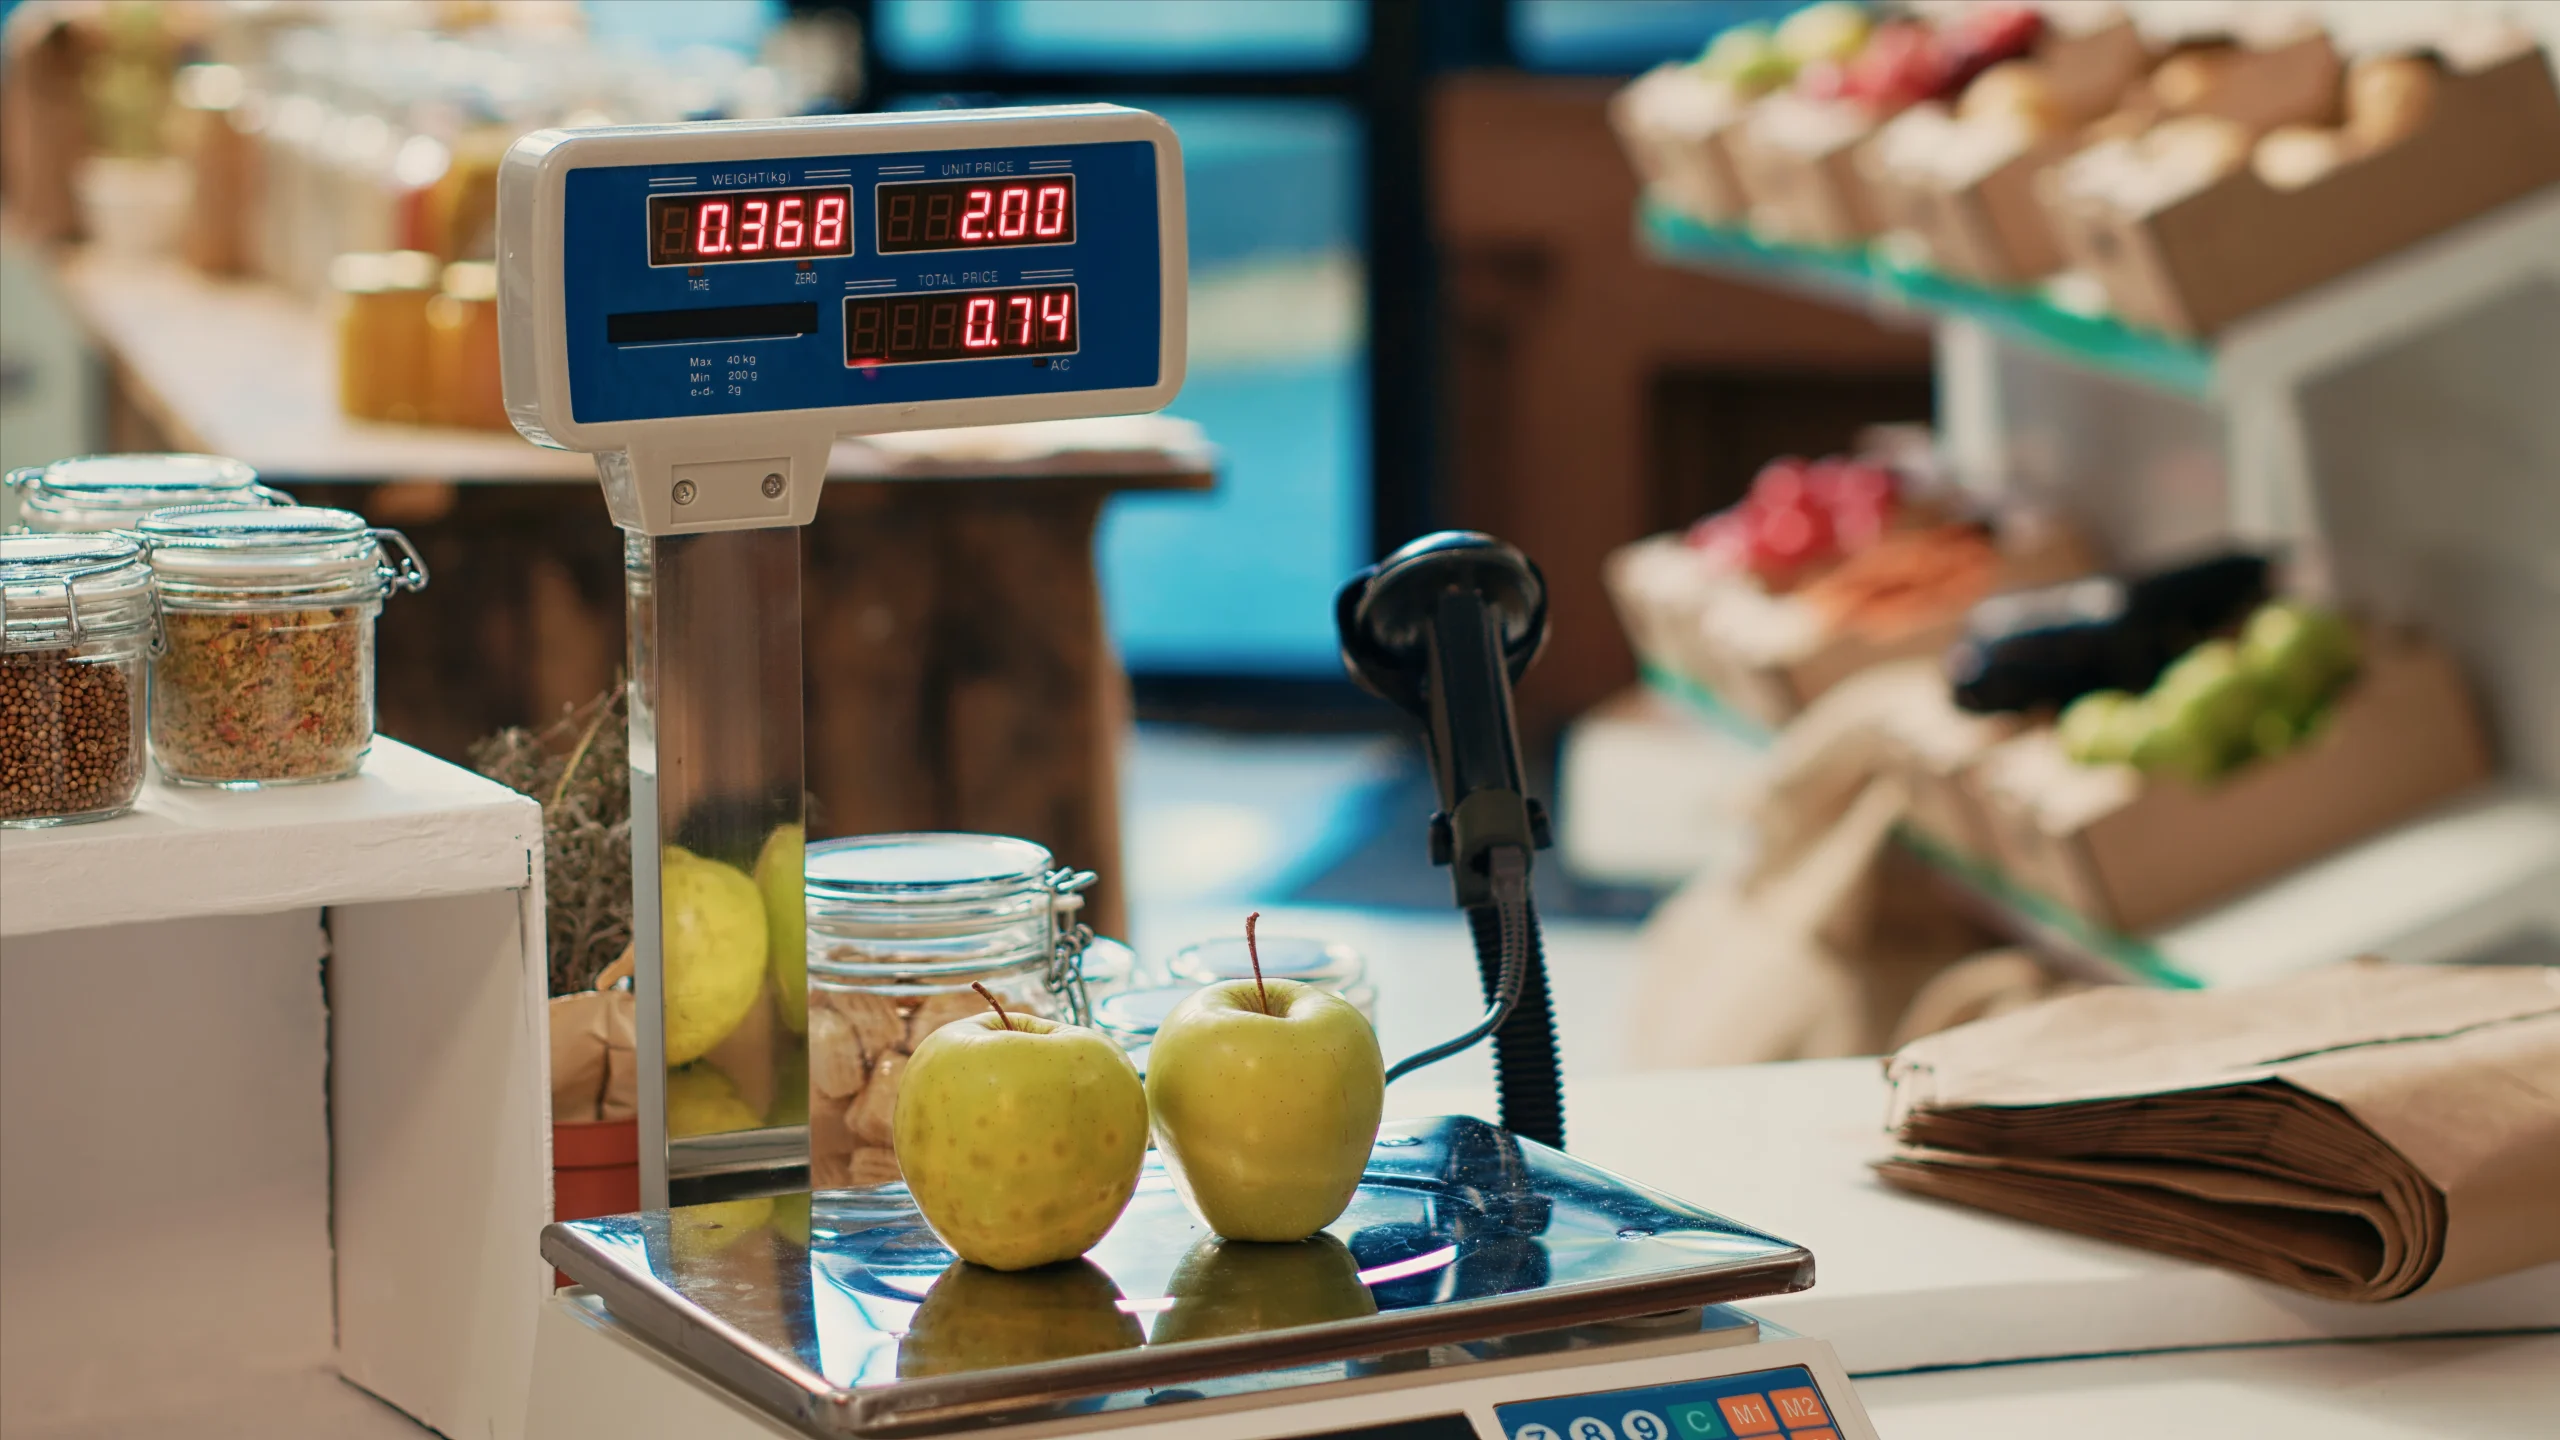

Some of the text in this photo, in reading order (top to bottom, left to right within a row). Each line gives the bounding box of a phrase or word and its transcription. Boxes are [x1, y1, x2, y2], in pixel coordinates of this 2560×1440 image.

[941, 161, 1014, 175] UNIT PRICE
[712, 171, 791, 186] WEIGHT(kg)
[961, 187, 1065, 240] 2.00
[697, 198, 845, 253] 0.368
[688, 279, 710, 291] TARE
[795, 272, 817, 285] ZERO
[918, 271, 999, 286] TOTAL PRICE
[965, 294, 1069, 347] 0.74
[690, 354, 756, 367] Max 40 kg
[1051, 358, 1071, 371] AC
[690, 370, 758, 383] Min 200 g
[728, 384, 741, 396] 2g
[1732, 1403, 1767, 1425] M1
[1781, 1397, 1819, 1419] M2
[1633, 1416, 1659, 1440] 9
[1686, 1410, 1711, 1432] C
